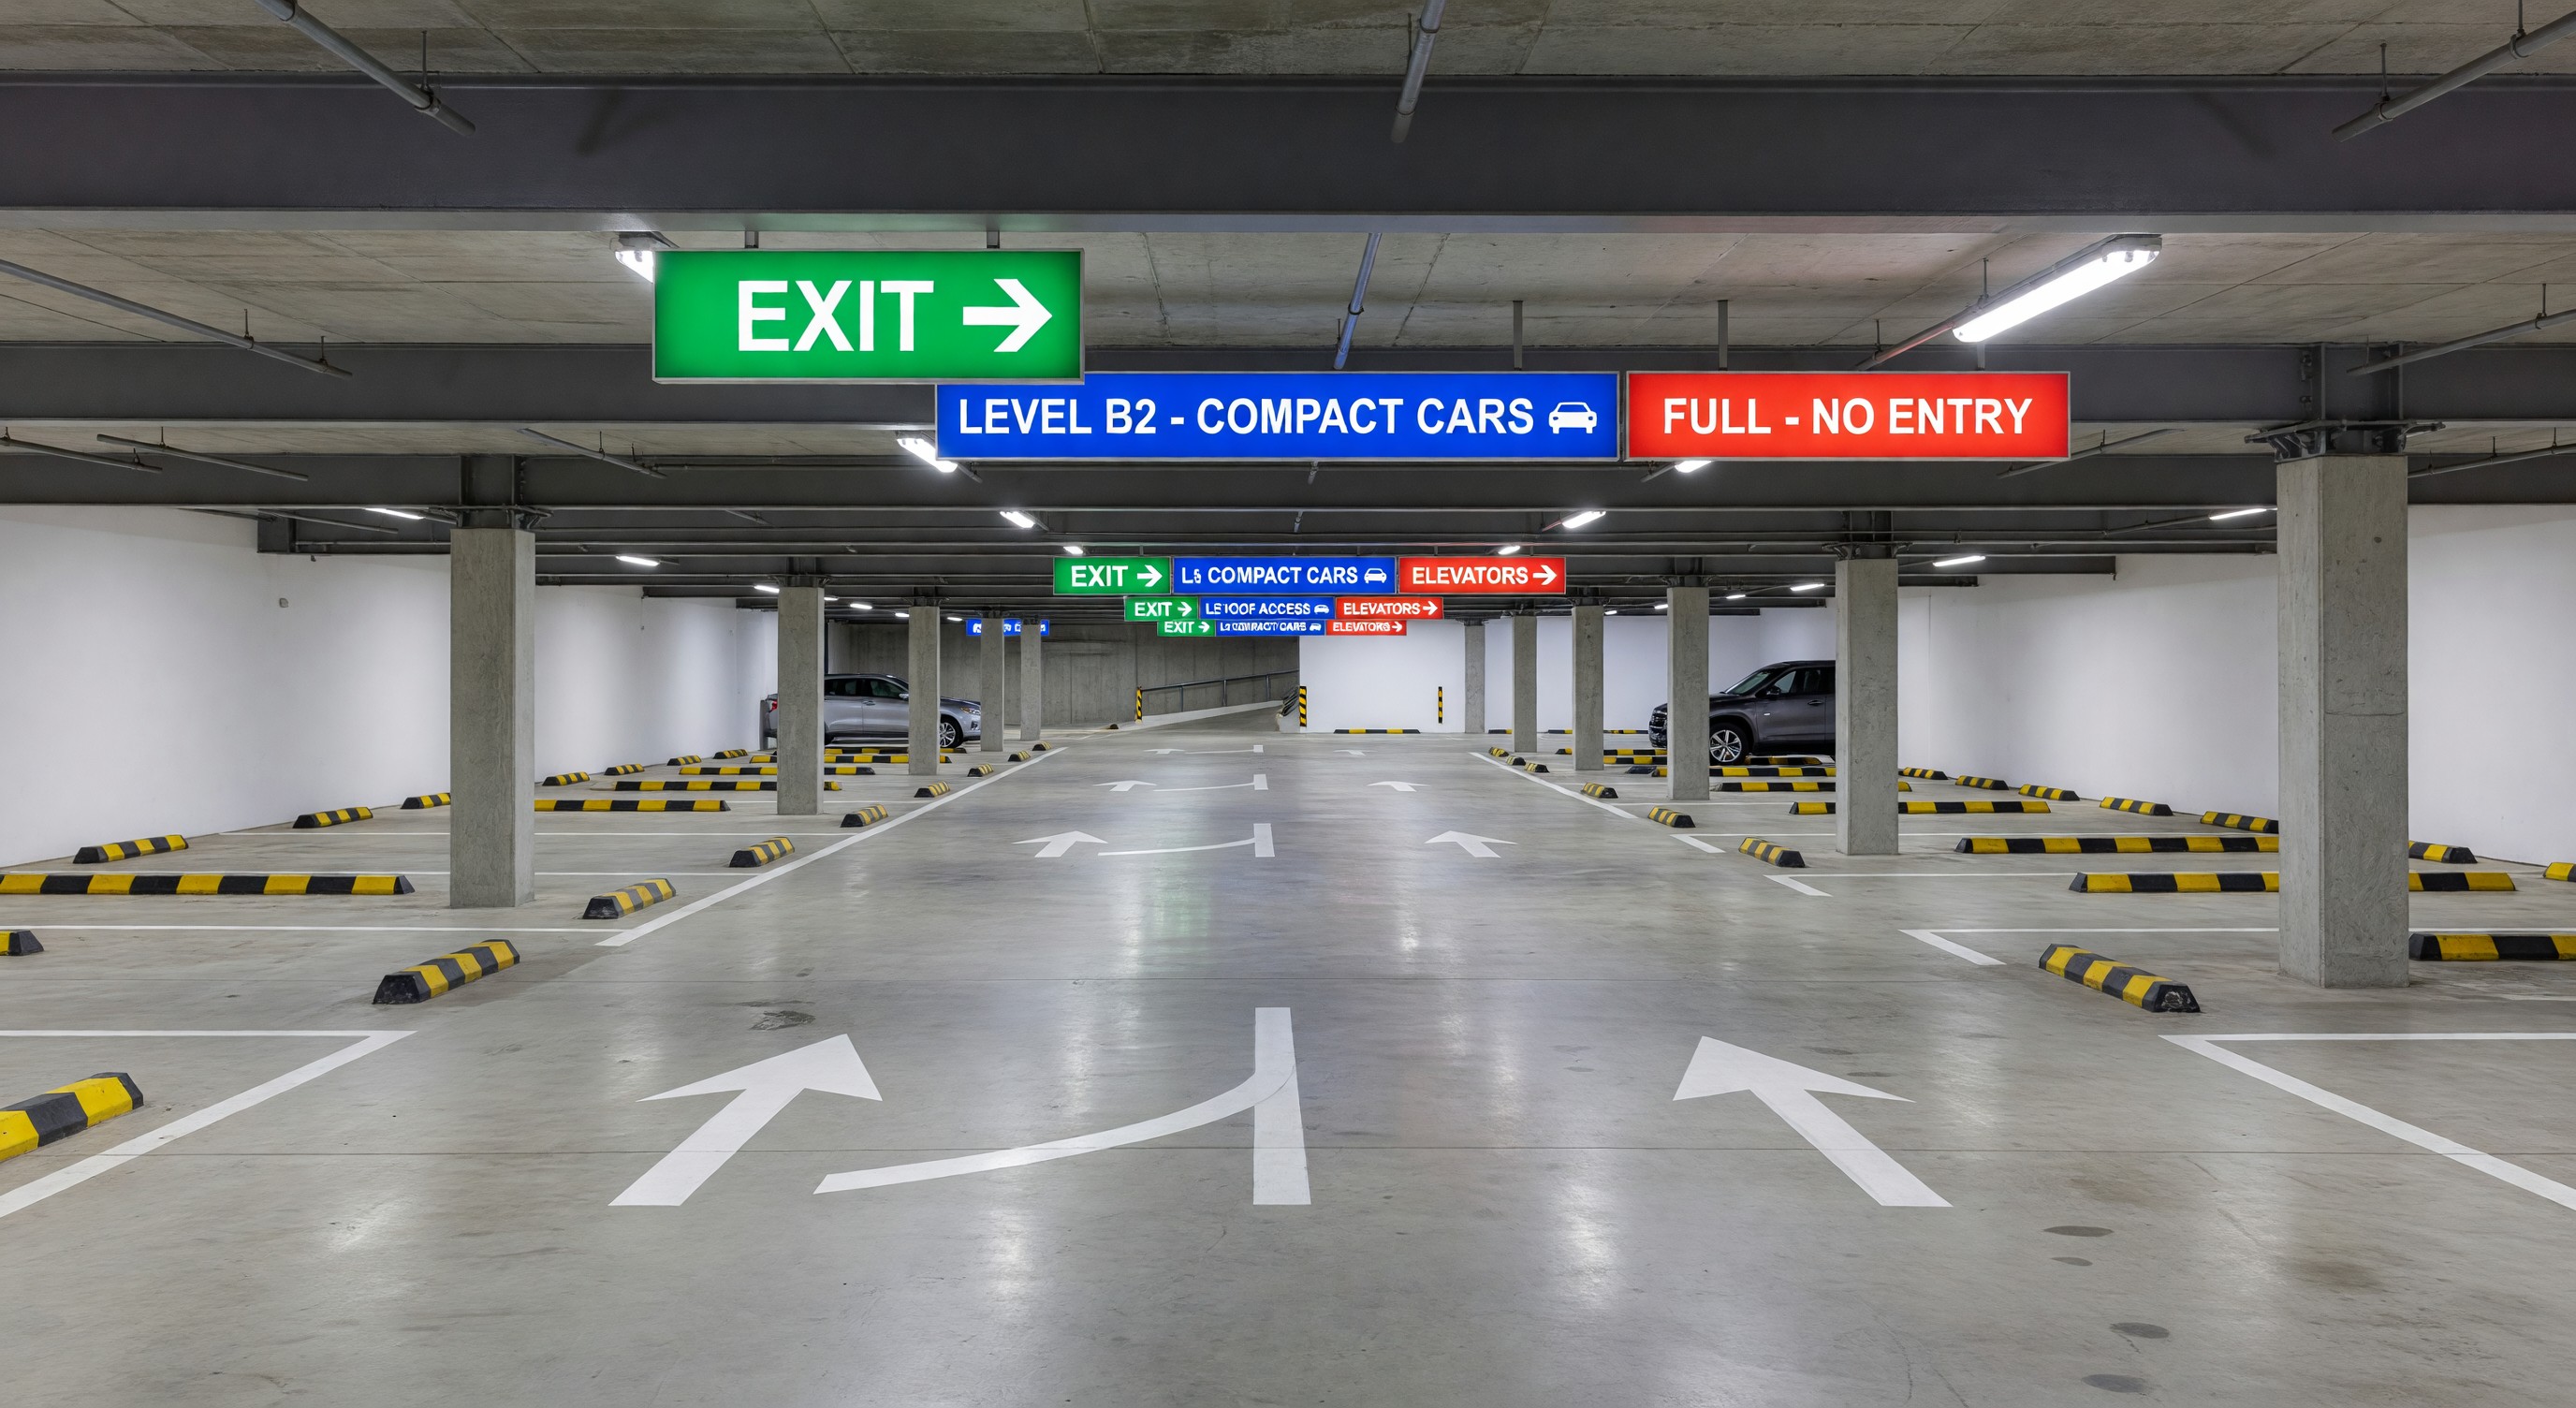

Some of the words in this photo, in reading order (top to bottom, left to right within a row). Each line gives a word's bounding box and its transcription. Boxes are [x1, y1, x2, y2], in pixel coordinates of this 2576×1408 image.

[738, 280, 934, 352] EXIT
[959, 398, 1092, 434] LEVEL
[1105, 398, 1157, 434] B2
[1170, 416, 1185, 425] -
[1197, 398, 1404, 434] COMPACT
[1416, 398, 1534, 434] CARS
[1663, 398, 1772, 435] FULL
[1784, 416, 1800, 426] -
[1812, 398, 1875, 435] NO
[1889, 398, 2033, 434] ENTRY
[1071, 565, 1129, 587] EXIT
[1208, 566, 1302, 584] COMPACT
[1306, 566, 1358, 584] CARS
[1412, 566, 1529, 585] ELEVATORS
[1134, 601, 1173, 617] EXIT
[1258, 602, 1311, 616] ACCESS
[1343, 602, 1421, 616] ELEVATORS
[1164, 621, 1195, 634] EXIT
